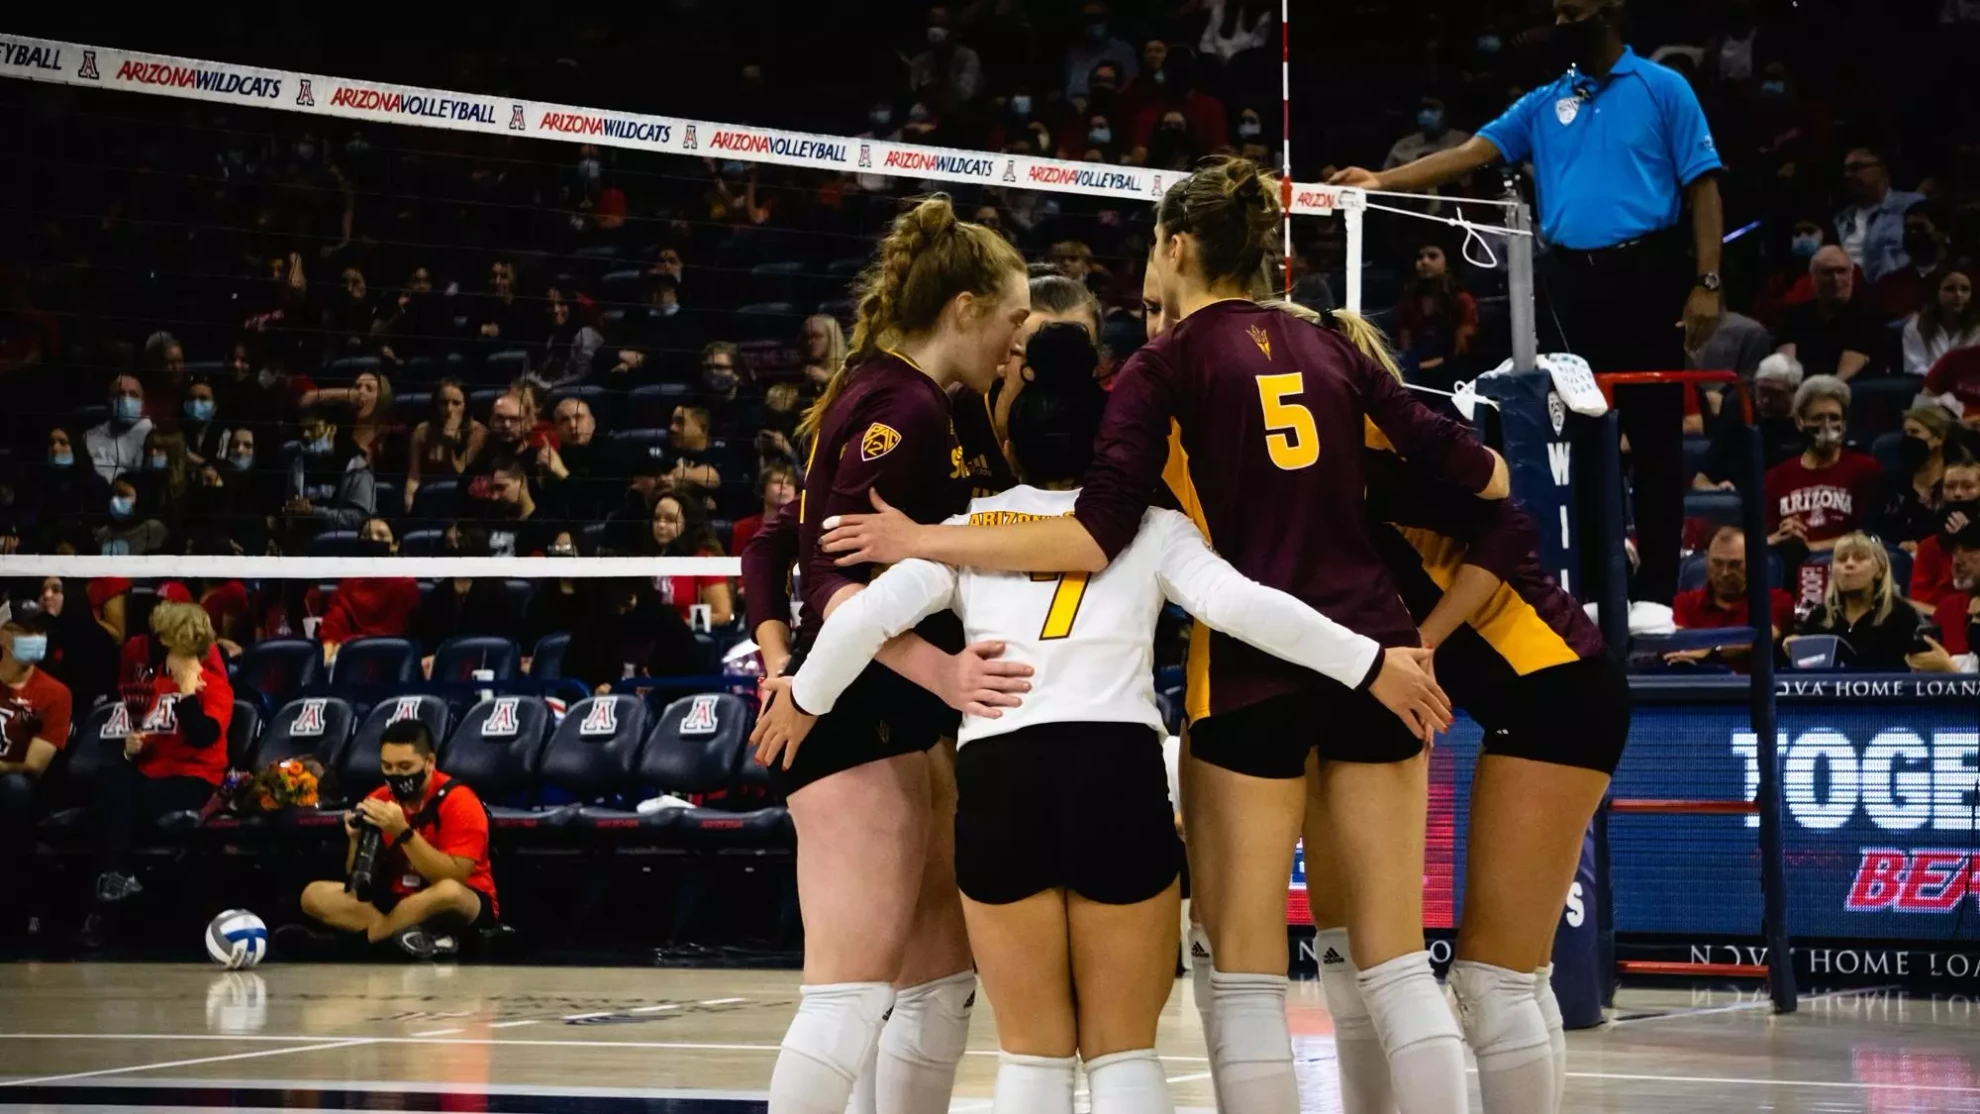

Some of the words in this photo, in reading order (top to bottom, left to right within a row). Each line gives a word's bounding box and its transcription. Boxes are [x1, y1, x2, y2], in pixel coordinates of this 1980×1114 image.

[1255, 371, 1320, 471] 5
[1780, 488, 1853, 517] ARIZONA
[1029, 571, 1092, 641] 7
[1836, 680, 1904, 696] HOME
[1916, 680, 1980, 696] LOAN
[1810, 950, 1910, 975] HOME
